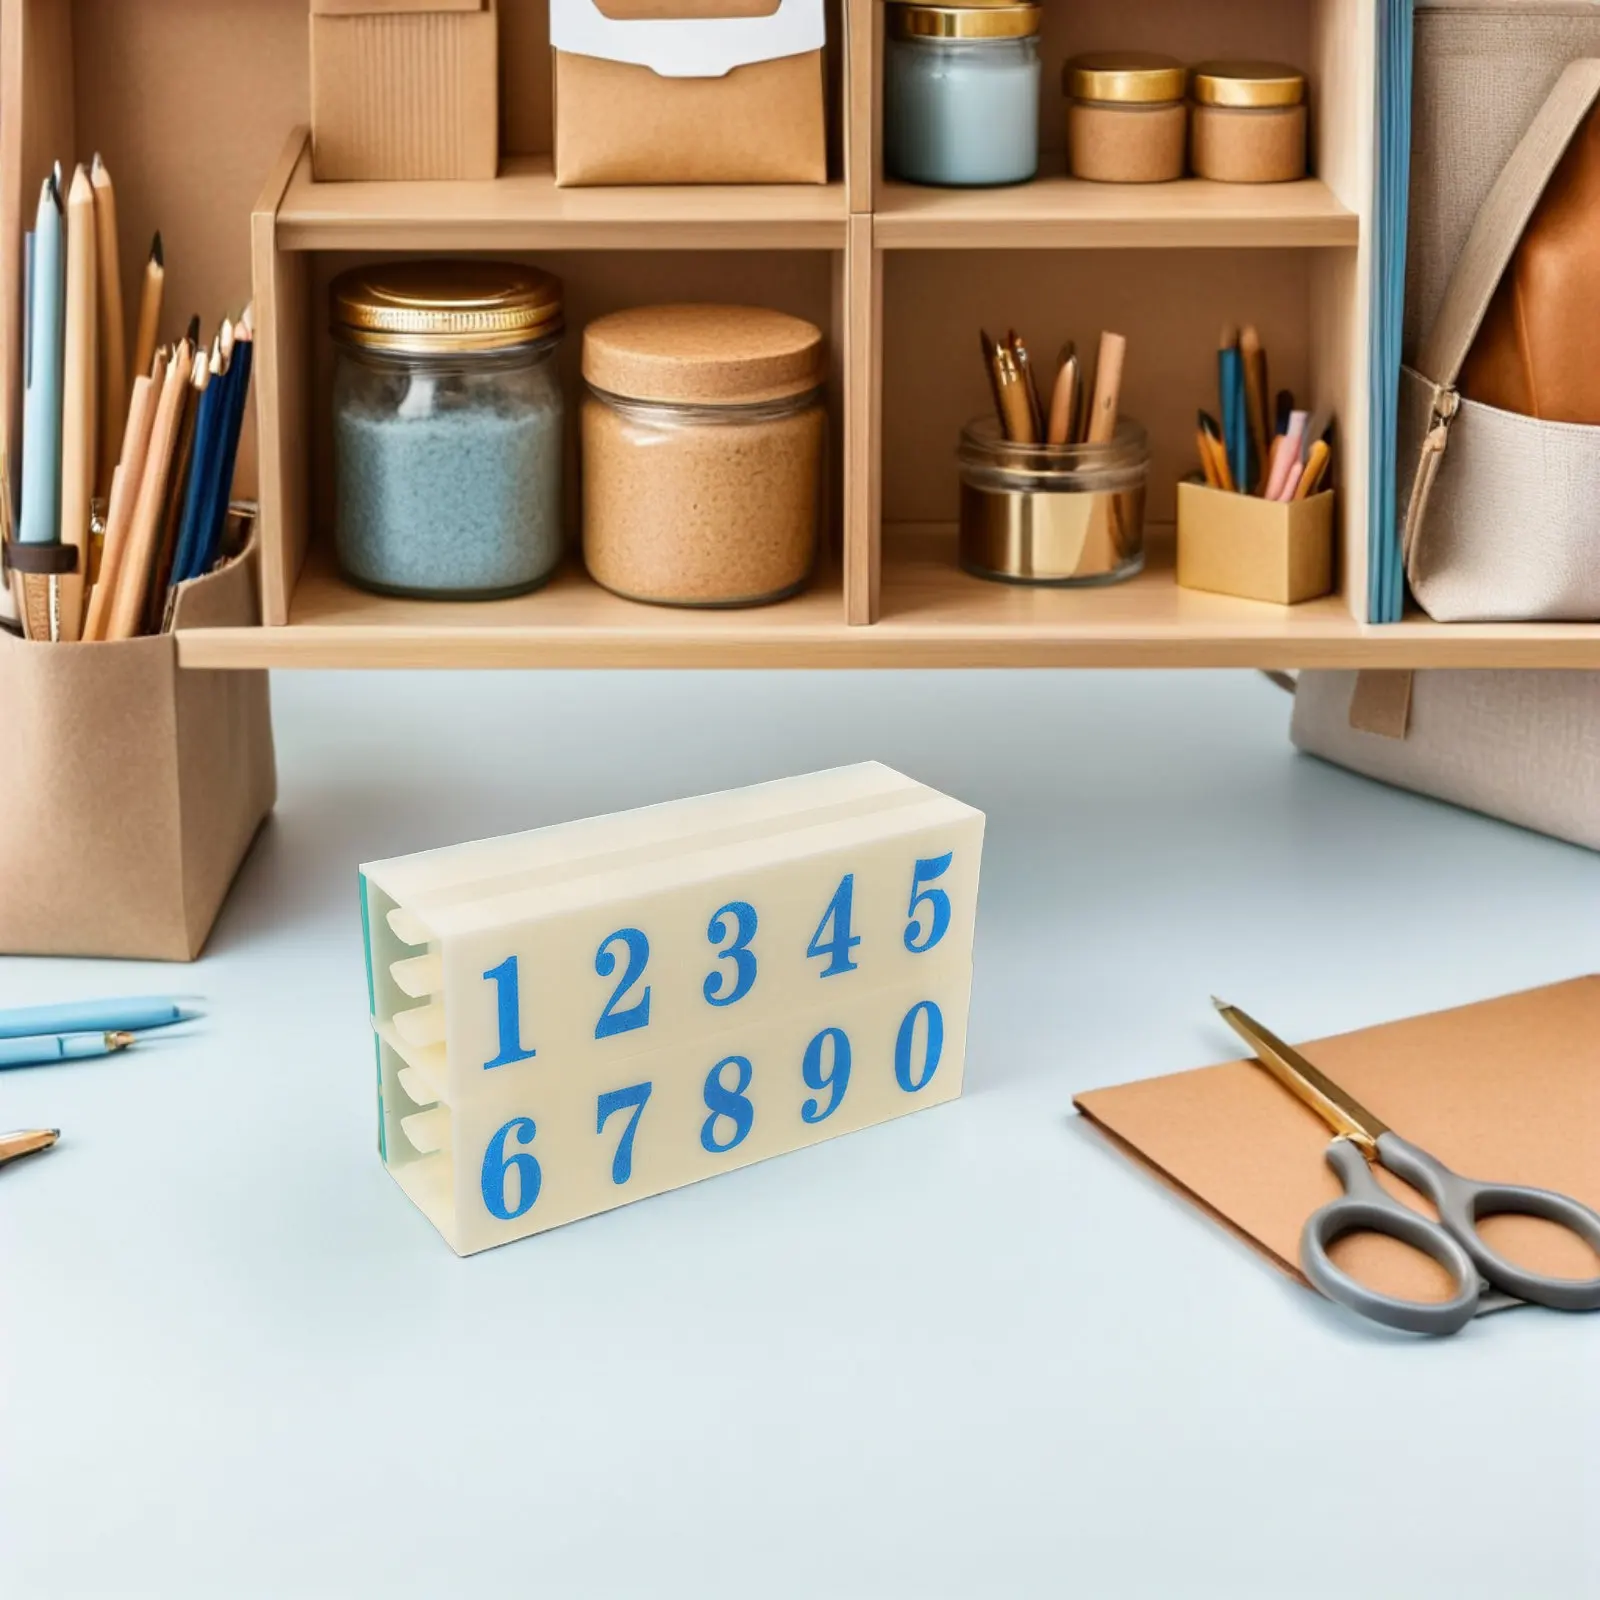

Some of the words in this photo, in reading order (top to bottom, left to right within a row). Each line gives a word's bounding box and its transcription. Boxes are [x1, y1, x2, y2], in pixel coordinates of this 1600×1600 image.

[484, 956, 535, 1070] 1
[595, 928, 650, 1038] 2
[704, 902, 757, 1006] 3
[807, 874, 860, 978] 4
[904, 852, 952, 953] 5
[481, 1118, 541, 1219] 6
[597, 1082, 651, 1184] 7
[701, 1056, 754, 1152] 8
[802, 1028, 851, 1123] 9
[895, 1001, 943, 1092] 0
